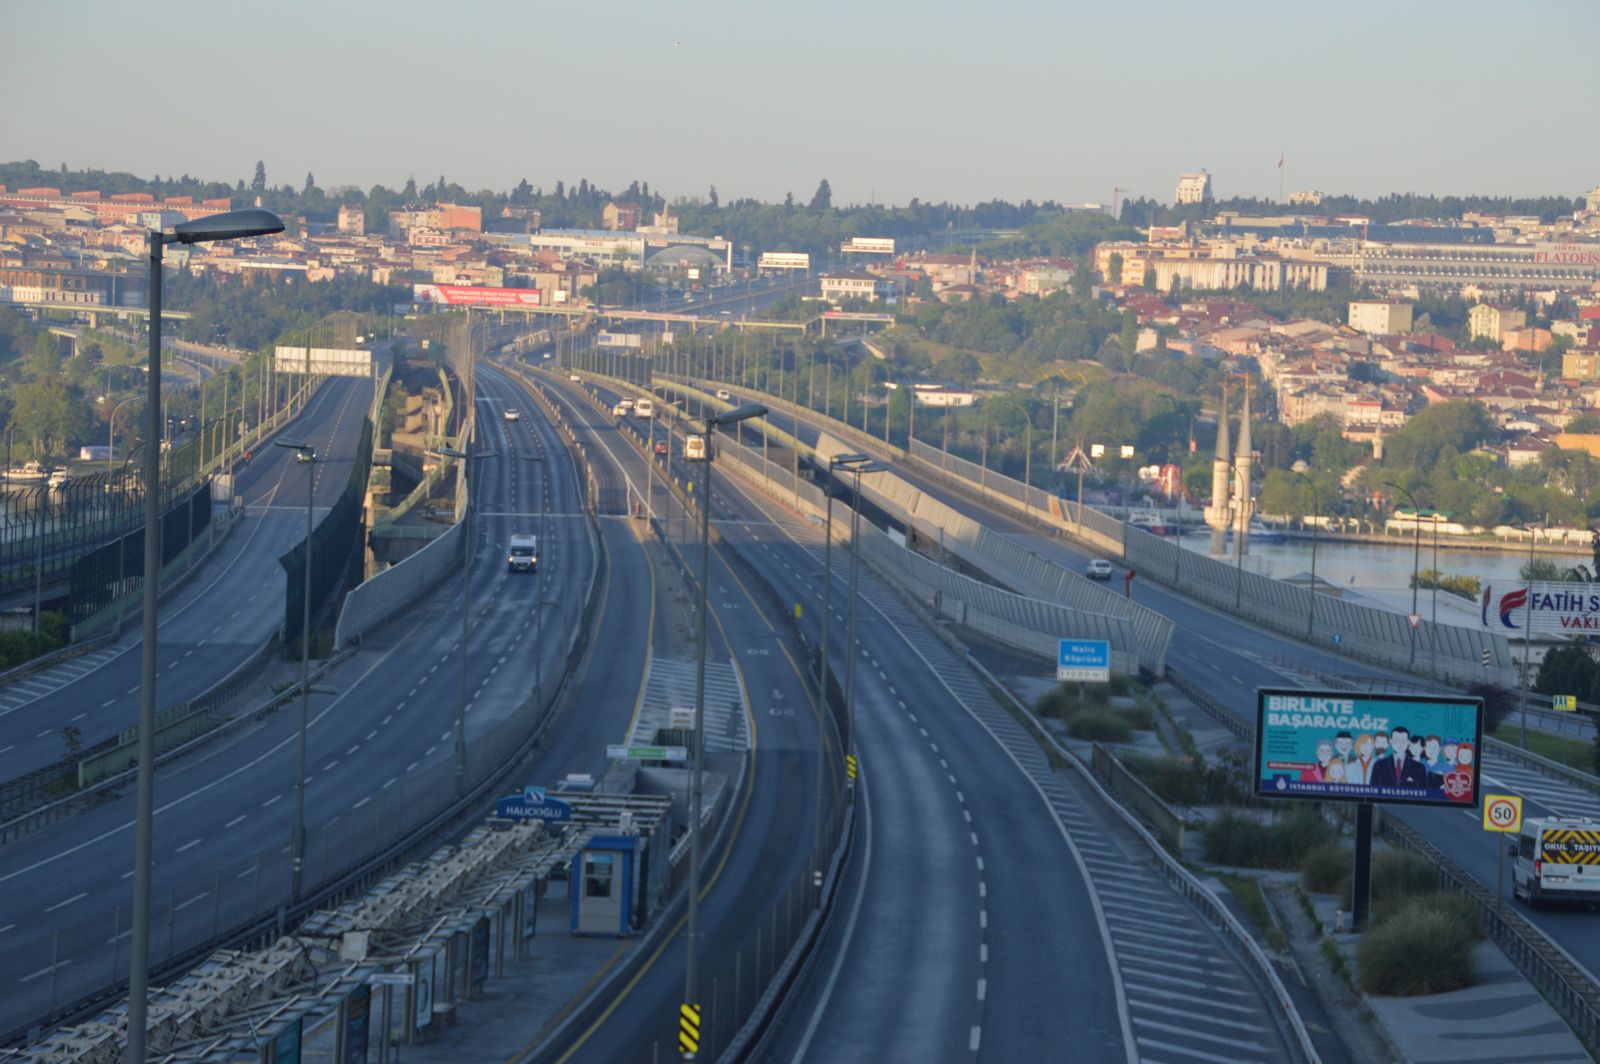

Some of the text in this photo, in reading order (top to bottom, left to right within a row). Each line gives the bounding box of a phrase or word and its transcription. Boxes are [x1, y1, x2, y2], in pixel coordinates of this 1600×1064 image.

[1532, 590, 1583, 611] FATİH
[1269, 697, 1354, 714] BİRLİKTE
[1268, 713, 1388, 731] BAŞARACAĞIZ
[1289, 783, 1326, 792] İSTANBUL
[1382, 787, 1426, 796] BELEDİYESİ
[506, 806, 561, 818] HALICIOĞLU
[1494, 808, 1512, 820] 50
[1544, 842, 1568, 851] OKUL
